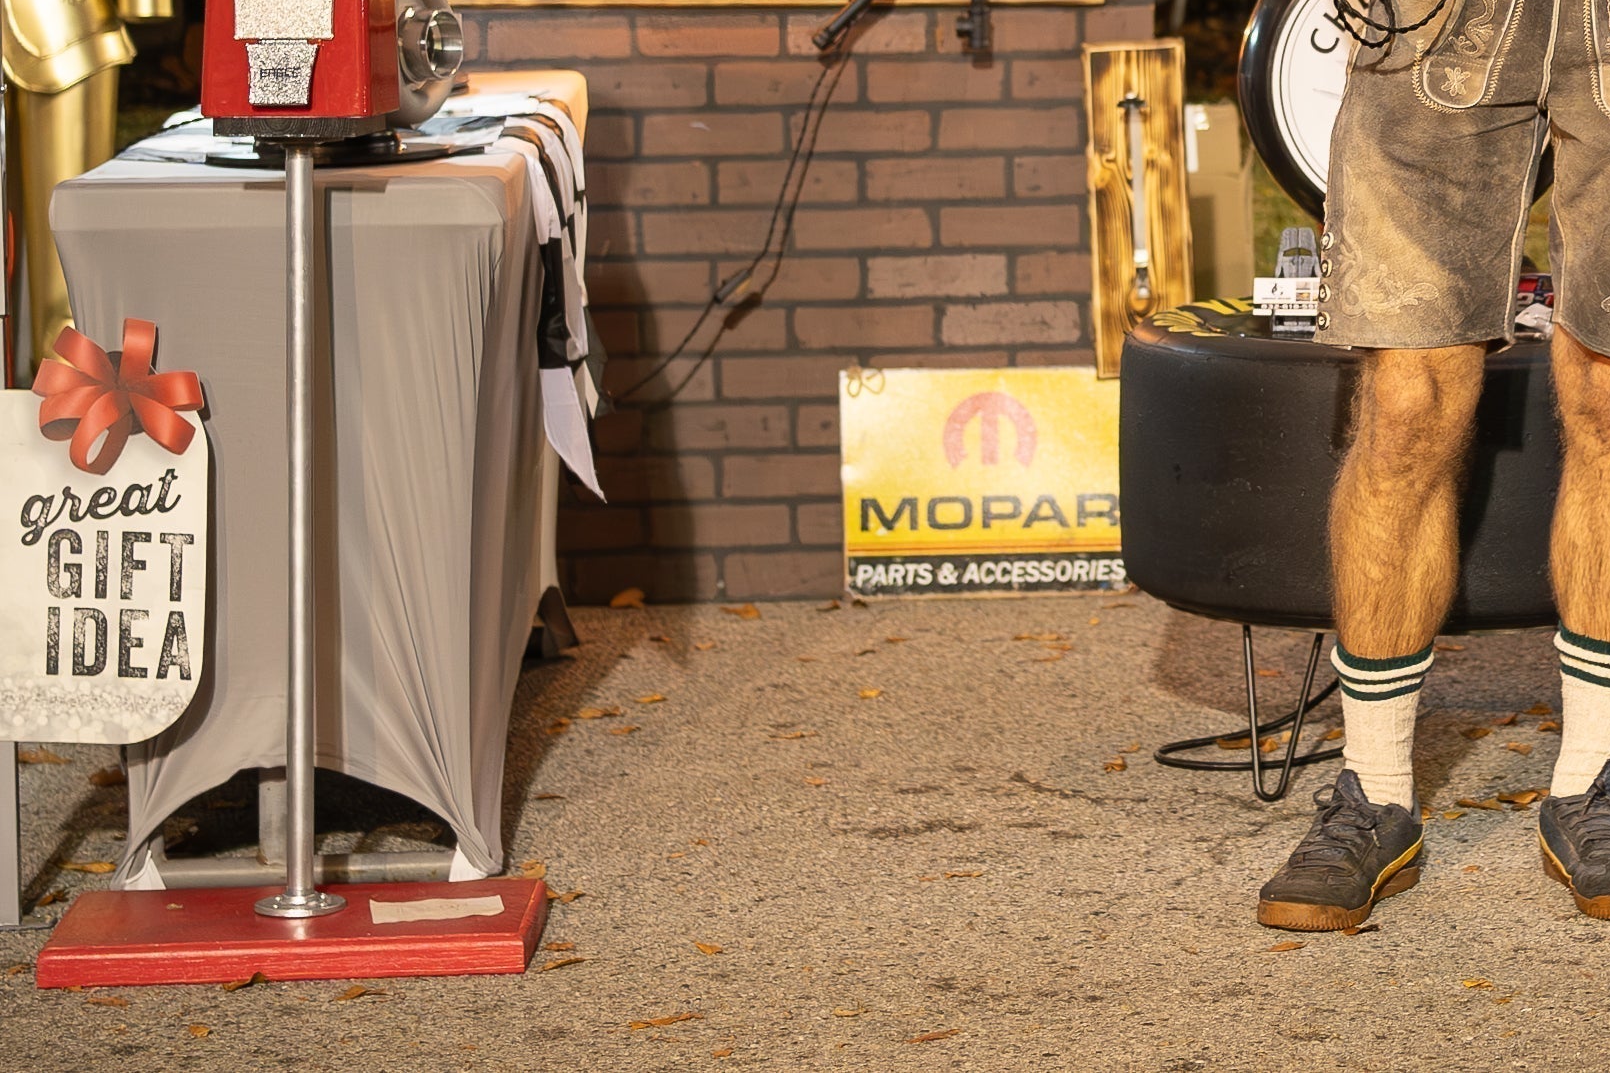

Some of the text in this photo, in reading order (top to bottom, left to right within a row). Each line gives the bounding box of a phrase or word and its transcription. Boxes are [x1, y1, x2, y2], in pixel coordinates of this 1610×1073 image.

[21, 468, 181, 546] great
[860, 493, 1120, 532] MOPAR
[47, 528, 195, 602] GIFT
[856, 558, 1127, 587] PARTS & ACCESSORIES
[46, 606, 192, 681] IDEA
